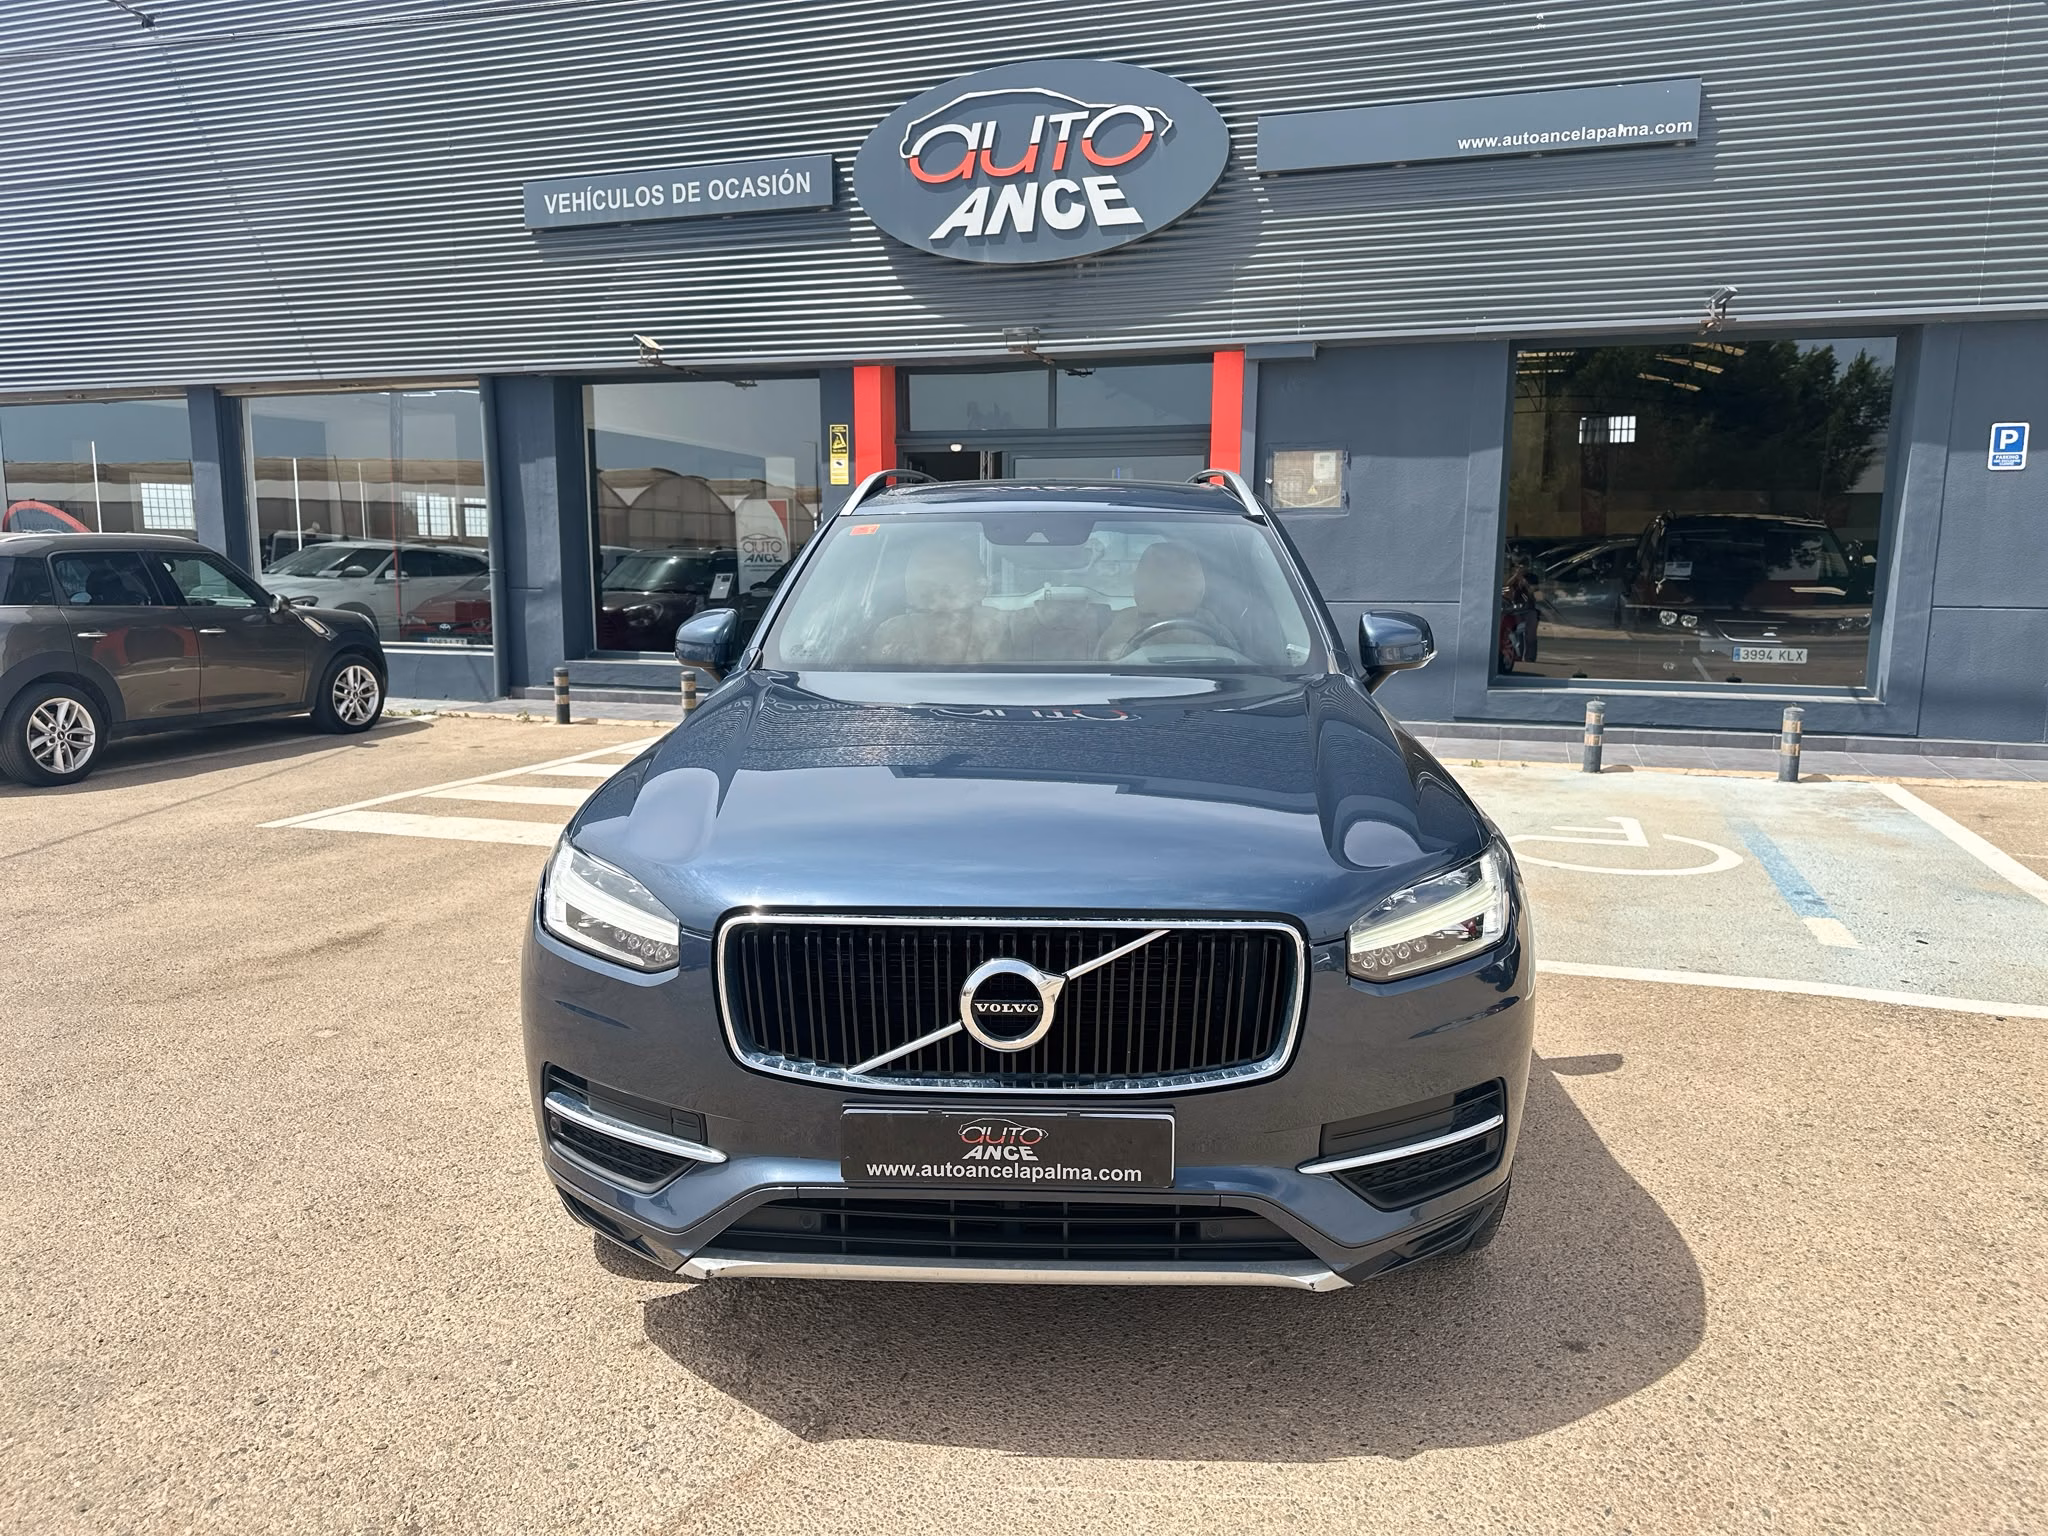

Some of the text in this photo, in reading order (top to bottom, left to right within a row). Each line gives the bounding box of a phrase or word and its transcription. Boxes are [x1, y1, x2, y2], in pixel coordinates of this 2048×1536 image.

[1457, 120, 1693, 150] www.autoancelapalma.com
[544, 168, 811, 215] VEHÍCULOS DE OCASIÓN
[928, 175, 1144, 240] ANCE
[1999, 429, 2019, 450] P
[1742, 649, 1804, 662] 3994 KLX
[974, 1003, 1039, 1013] VOLVO
[961, 1145, 1039, 1162] ANCE
[866, 1162, 1142, 1184] www.autoancelapalma.com
